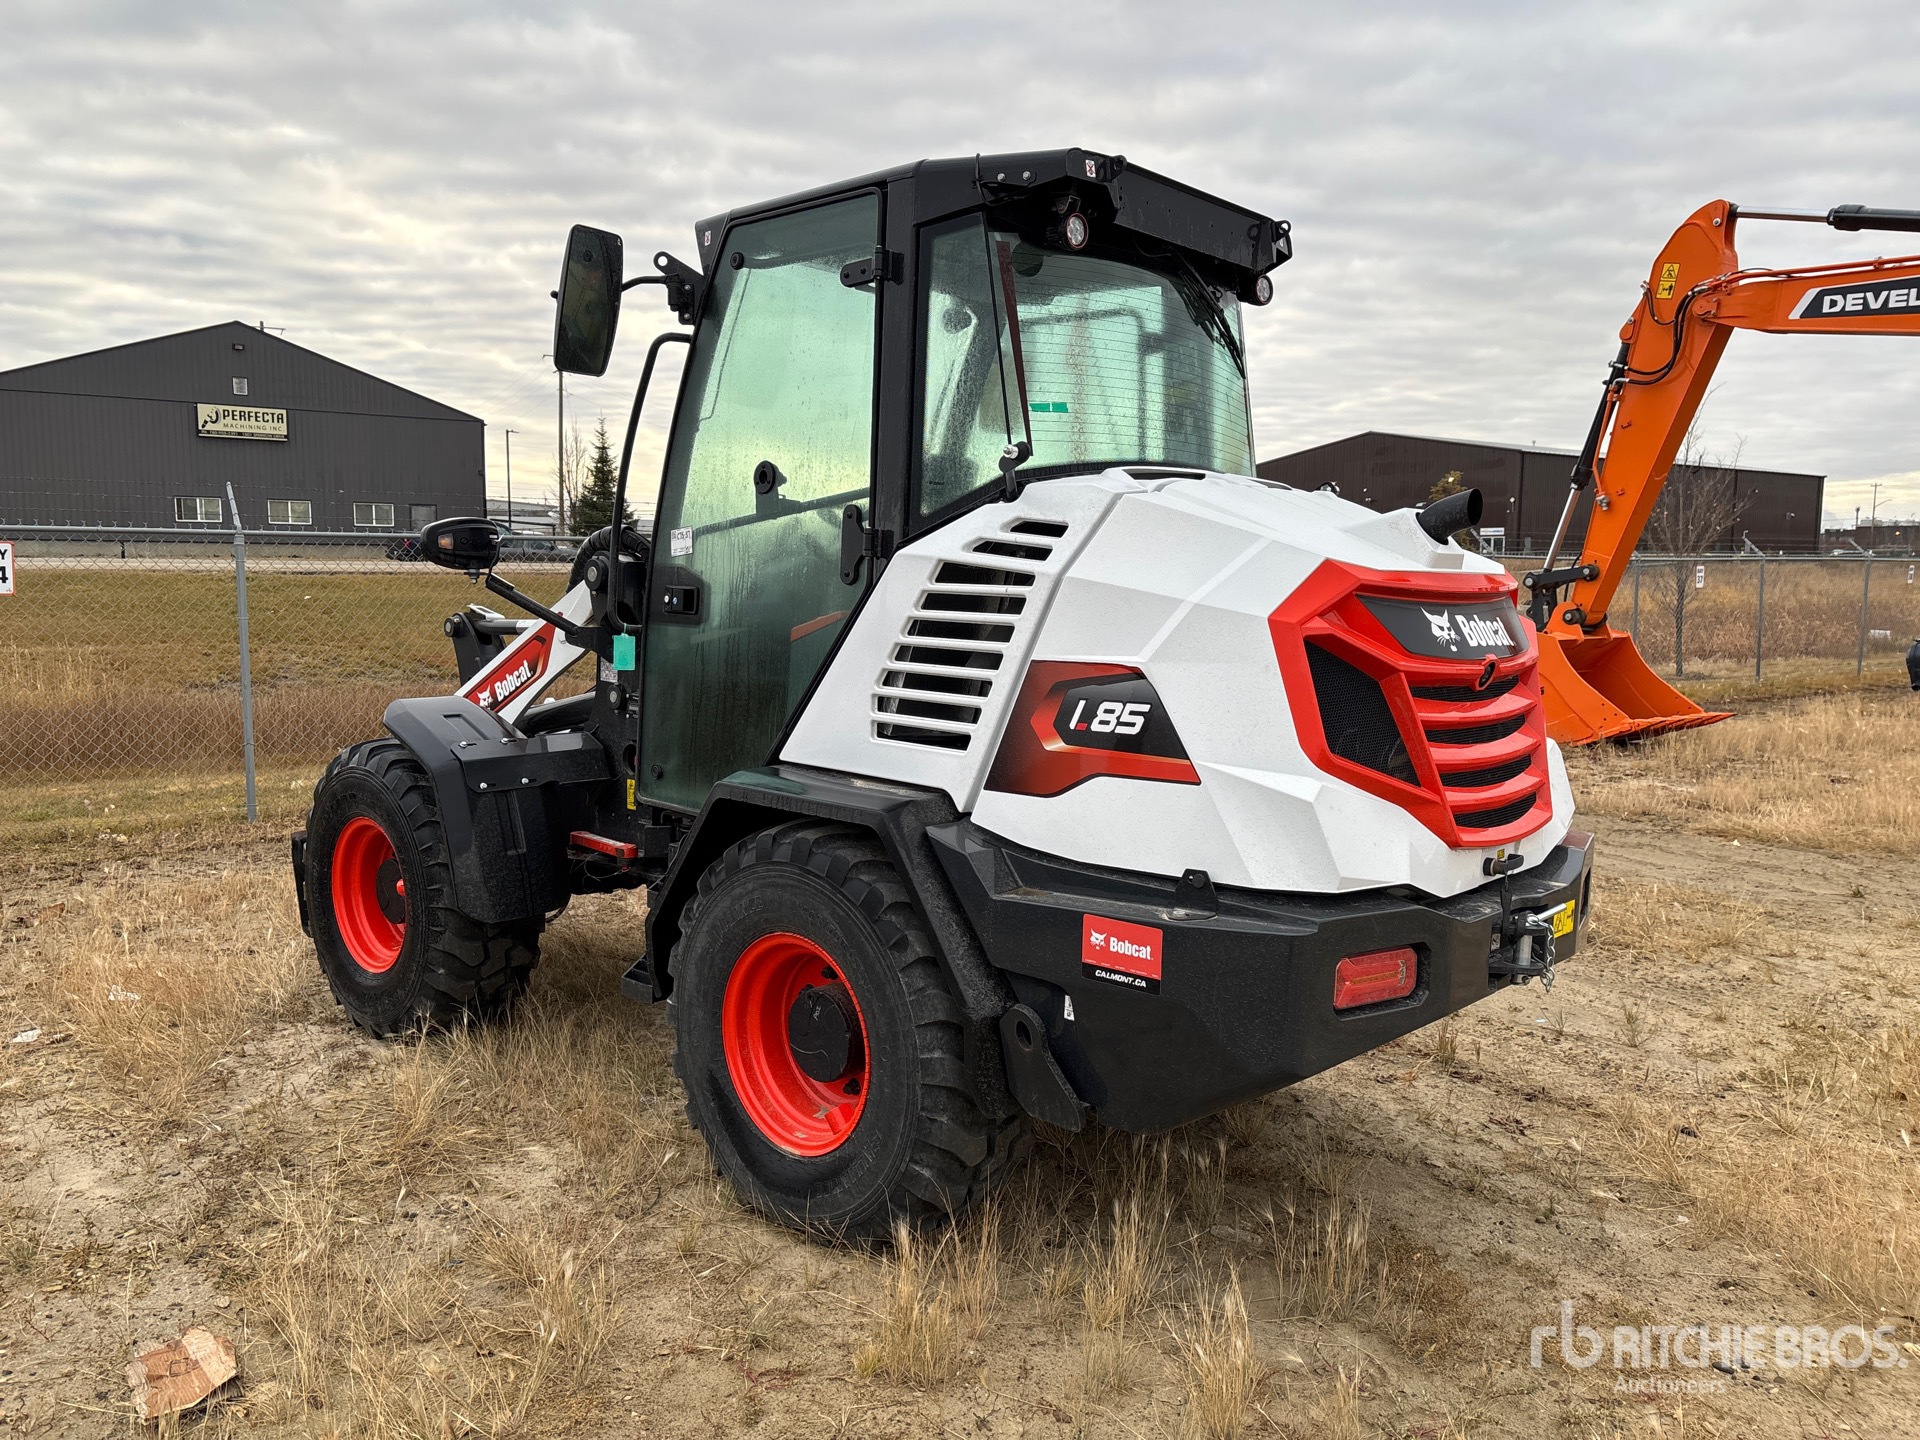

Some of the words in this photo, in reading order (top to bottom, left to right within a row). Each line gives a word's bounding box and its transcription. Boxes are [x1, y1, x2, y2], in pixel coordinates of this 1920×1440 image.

[1822, 287, 1920, 313] DEVEL
[222, 409, 284, 424] PERFECTA
[223, 423, 267, 431] MACHINING
[1455, 614, 1515, 647] Bobcat
[494, 659, 532, 702] Bobcat
[1109, 936, 1152, 960] Bobcat
[1095, 969, 1147, 988] CALMONT.CA
